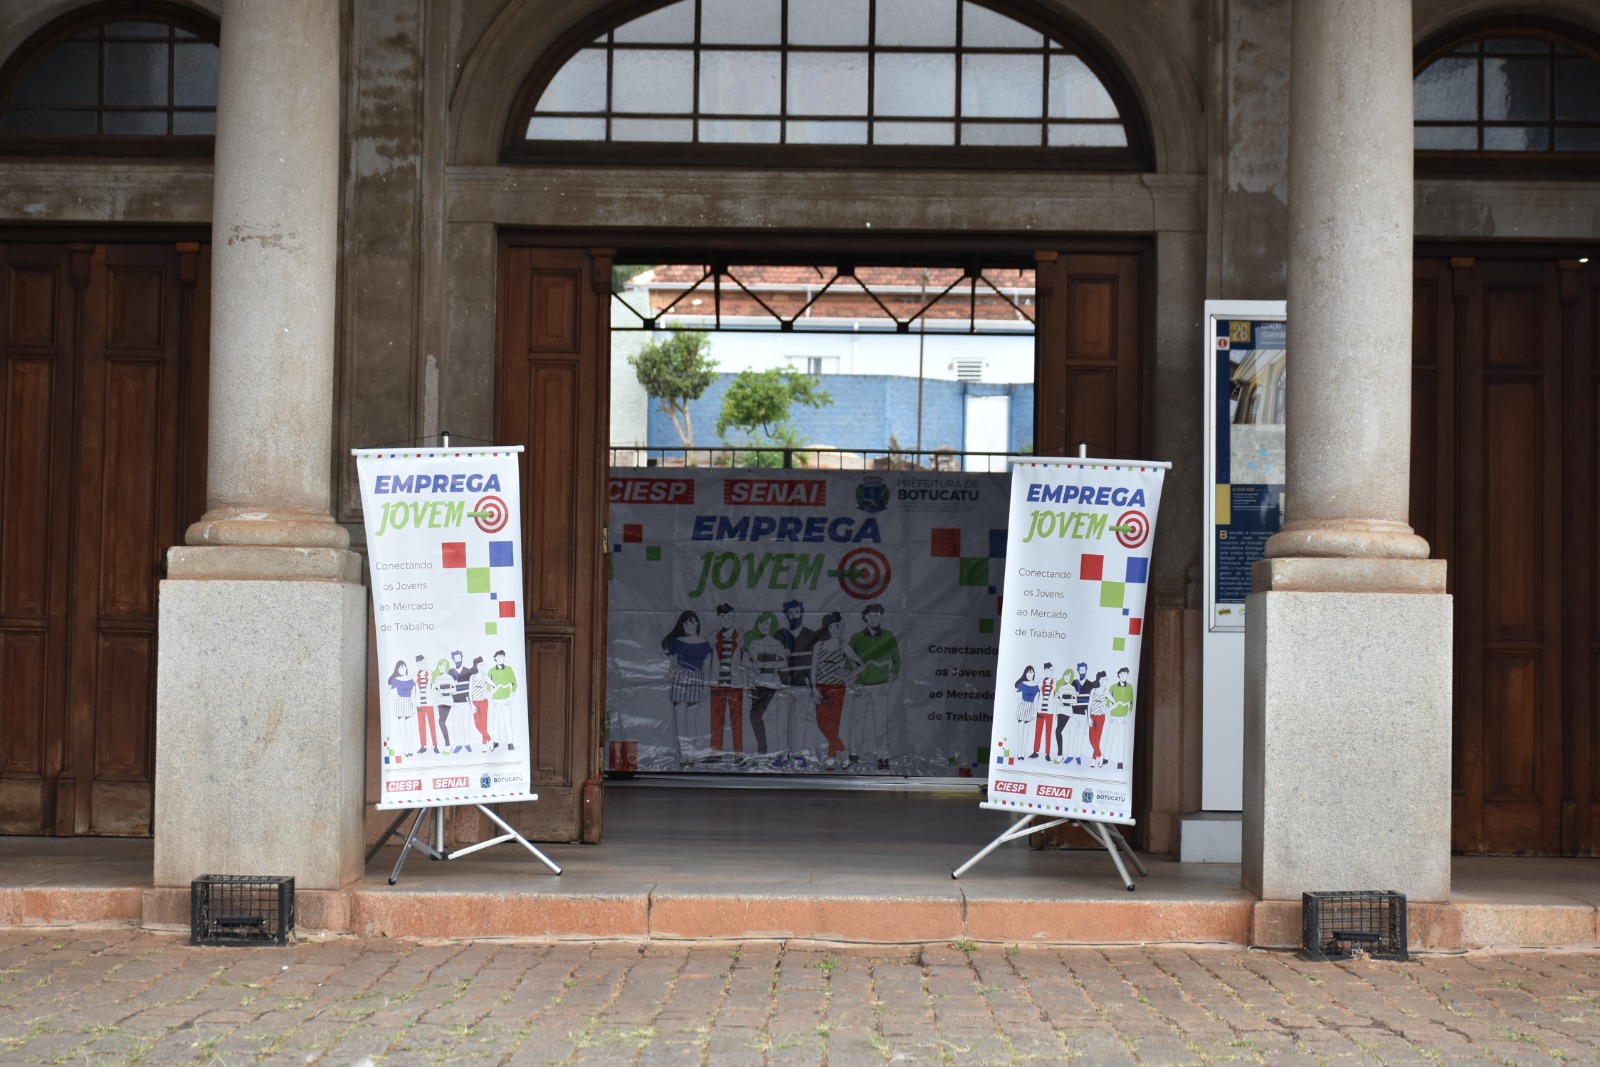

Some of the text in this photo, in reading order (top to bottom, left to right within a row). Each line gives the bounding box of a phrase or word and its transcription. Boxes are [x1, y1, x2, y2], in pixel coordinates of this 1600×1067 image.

[1233, 324, 1248, 341] 26
[374, 473, 501, 494] EMPREGA
[897, 479, 979, 489] PREFEITURA DE
[609, 480, 687, 501] CIESP
[731, 481, 821, 503] SENAI
[897, 489, 979, 501] BOTUCATU
[1026, 484, 1146, 507] EMPREGA
[375, 500, 465, 536] JOVEM
[691, 515, 882, 544] EMPREGA
[1022, 510, 1109, 543] JOVEM
[375, 561, 433, 571] Conectando
[688, 551, 825, 598] JOVEM
[1018, 567, 1072, 579] Conectando
[383, 581, 428, 591] os Jovens
[1023, 588, 1065, 599] os Jovens
[393, 602, 434, 611] Mercado
[1016, 608, 1068, 619] ao Mercado
[380, 621, 435, 632] de Trabalho
[1014, 627, 1067, 639] de Trabalho
[928, 644, 998, 656] Conectando
[935, 667, 991, 677] os Jovens
[928, 690, 943, 699] ao
[927, 711, 942, 721] de
[388, 781, 420, 791] CIESP
[435, 777, 467, 788] SENAI
[996, 782, 1025, 793] CIESP
[1038, 786, 1071, 798] SENAI
[1096, 794, 1126, 802] BOTUCATU
